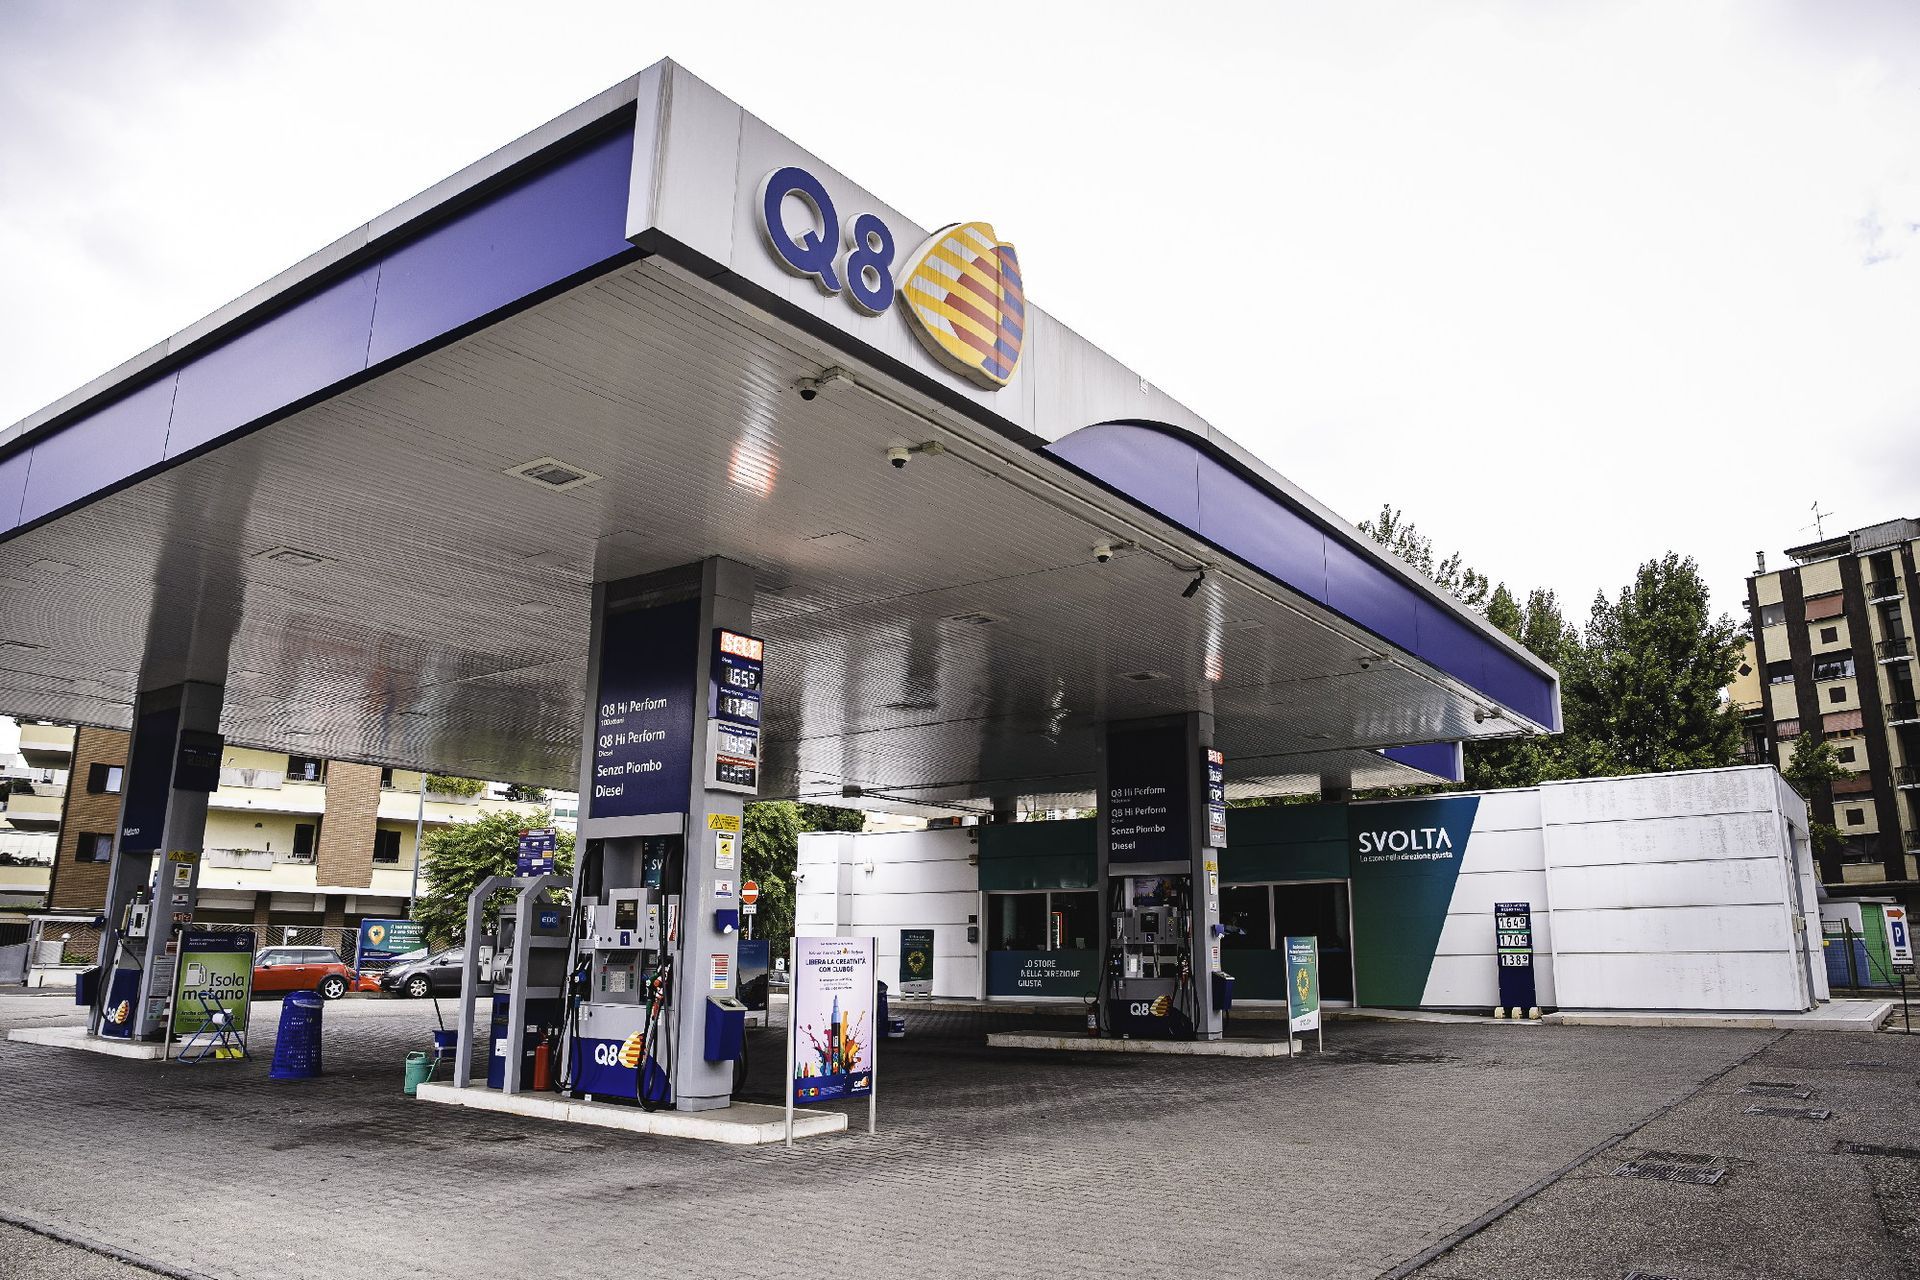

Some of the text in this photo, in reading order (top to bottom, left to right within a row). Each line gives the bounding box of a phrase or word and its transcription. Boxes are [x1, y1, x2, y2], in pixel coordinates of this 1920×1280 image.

[757, 166, 895, 316] Q8
[602, 698, 667, 718] Q8 Hi Perform
[600, 729, 666, 749] Q8 Hi Perform
[597, 759, 662, 777] Senza Piombo
[596, 783, 624, 798] Diesel
[1111, 786, 1166, 798] Q8 Hi Perform
[1111, 805, 1167, 818] Q8 Hi Perform
[1111, 824, 1166, 836] Senza Piombo
[1111, 841, 1136, 851] Diesel
[1359, 827, 1452, 853] SVOLTA
[1360, 851, 1453, 863] Lo store nella direzione giusta
[541, 915, 557, 924] EDC
[1894, 927, 1902, 943] P
[806, 958, 826, 966] LIBERA
[1024, 959, 1056, 968] LO STORE
[209, 972, 244, 987] Isola
[1020, 969, 1080, 978] NELLA DIREZIONE
[1018, 979, 1042, 988] GIUSTA
[1130, 1003, 1149, 1016] Q8
[595, 1043, 618, 1067] Q8
